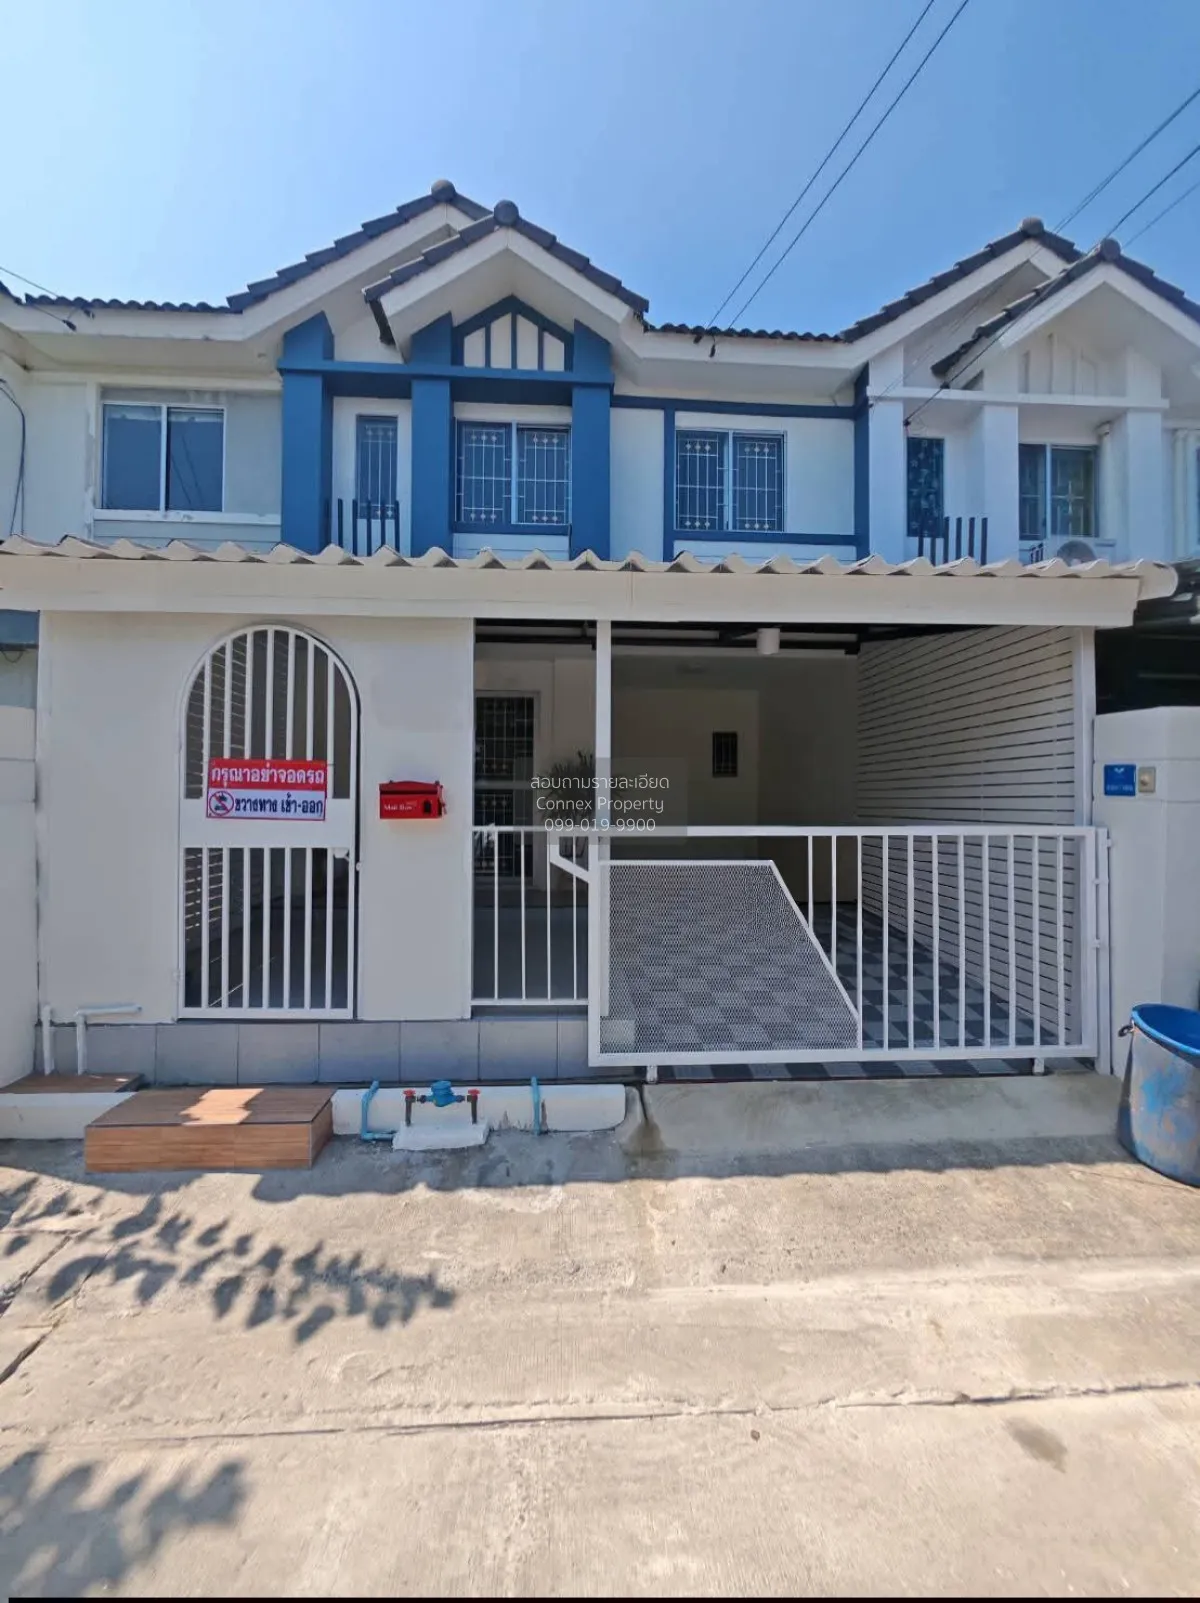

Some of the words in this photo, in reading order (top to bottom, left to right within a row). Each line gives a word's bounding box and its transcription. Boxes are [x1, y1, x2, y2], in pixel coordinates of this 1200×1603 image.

[211, 762, 325, 787] กรุณาอย่าจอดรถ
[234, 798, 278, 813] ขวางทาง
